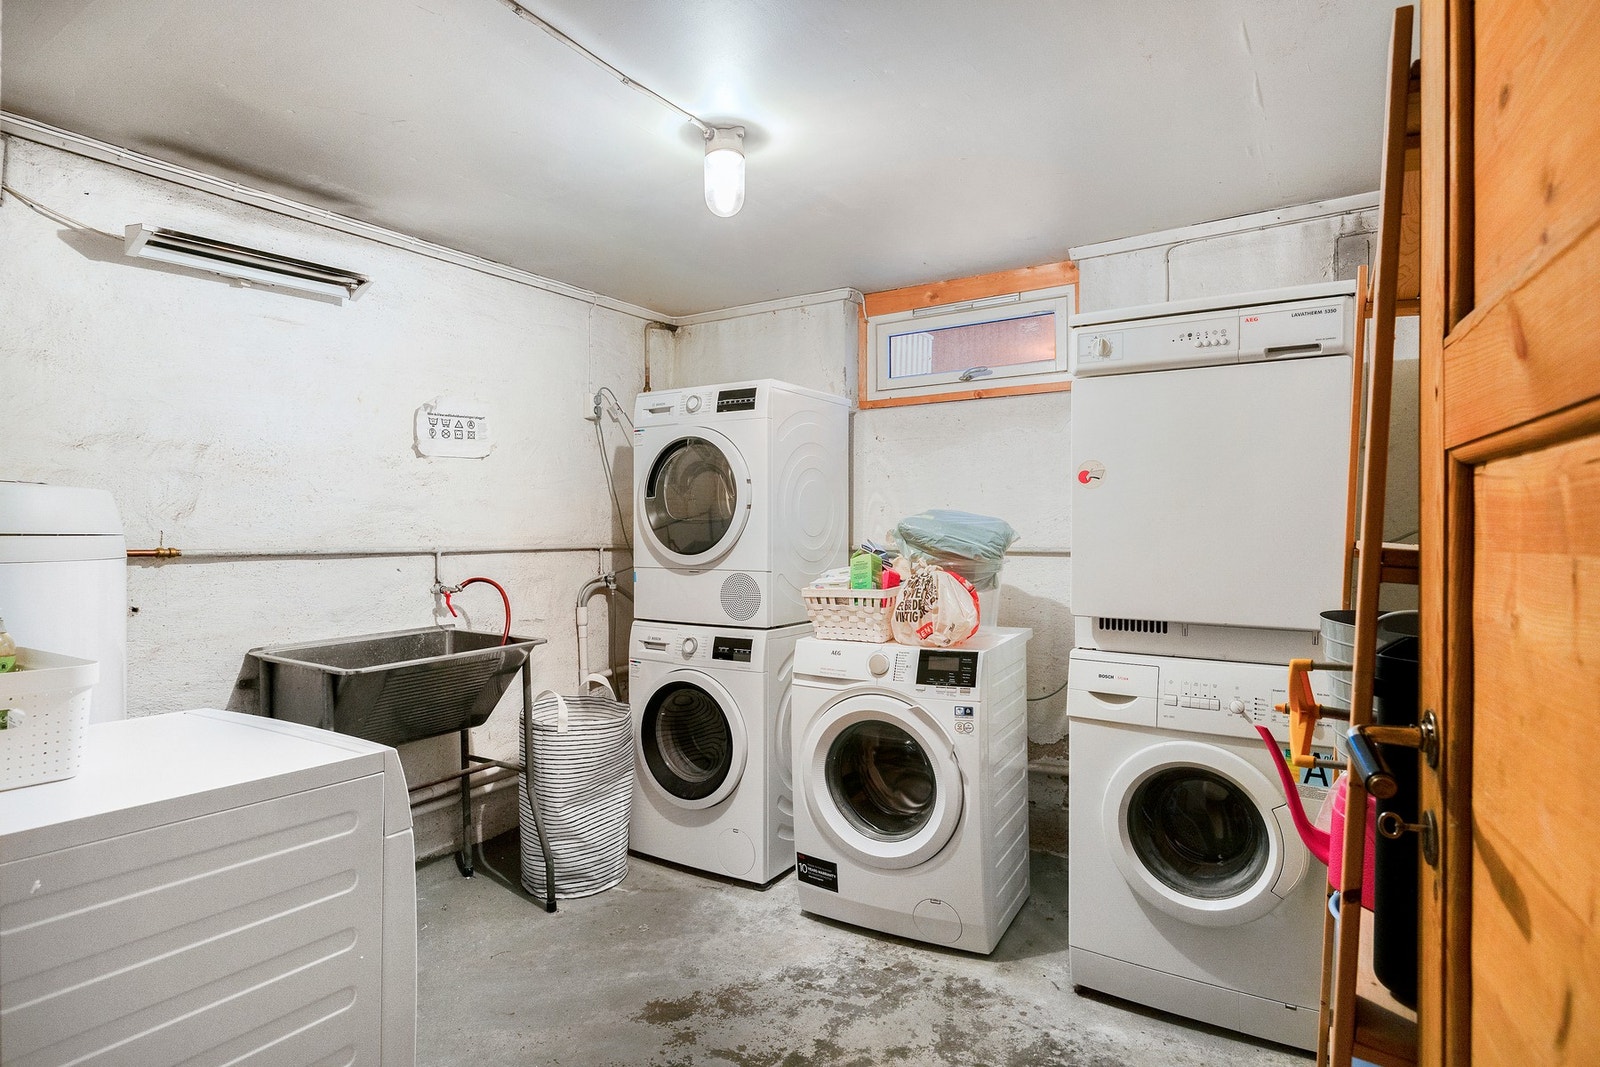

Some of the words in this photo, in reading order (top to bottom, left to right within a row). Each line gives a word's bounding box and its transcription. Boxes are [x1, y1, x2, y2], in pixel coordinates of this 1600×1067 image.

[1291, 309, 1323, 318] LAVATHERM
[1303, 752, 1329, 788] A
[798, 862, 808, 874] 10
